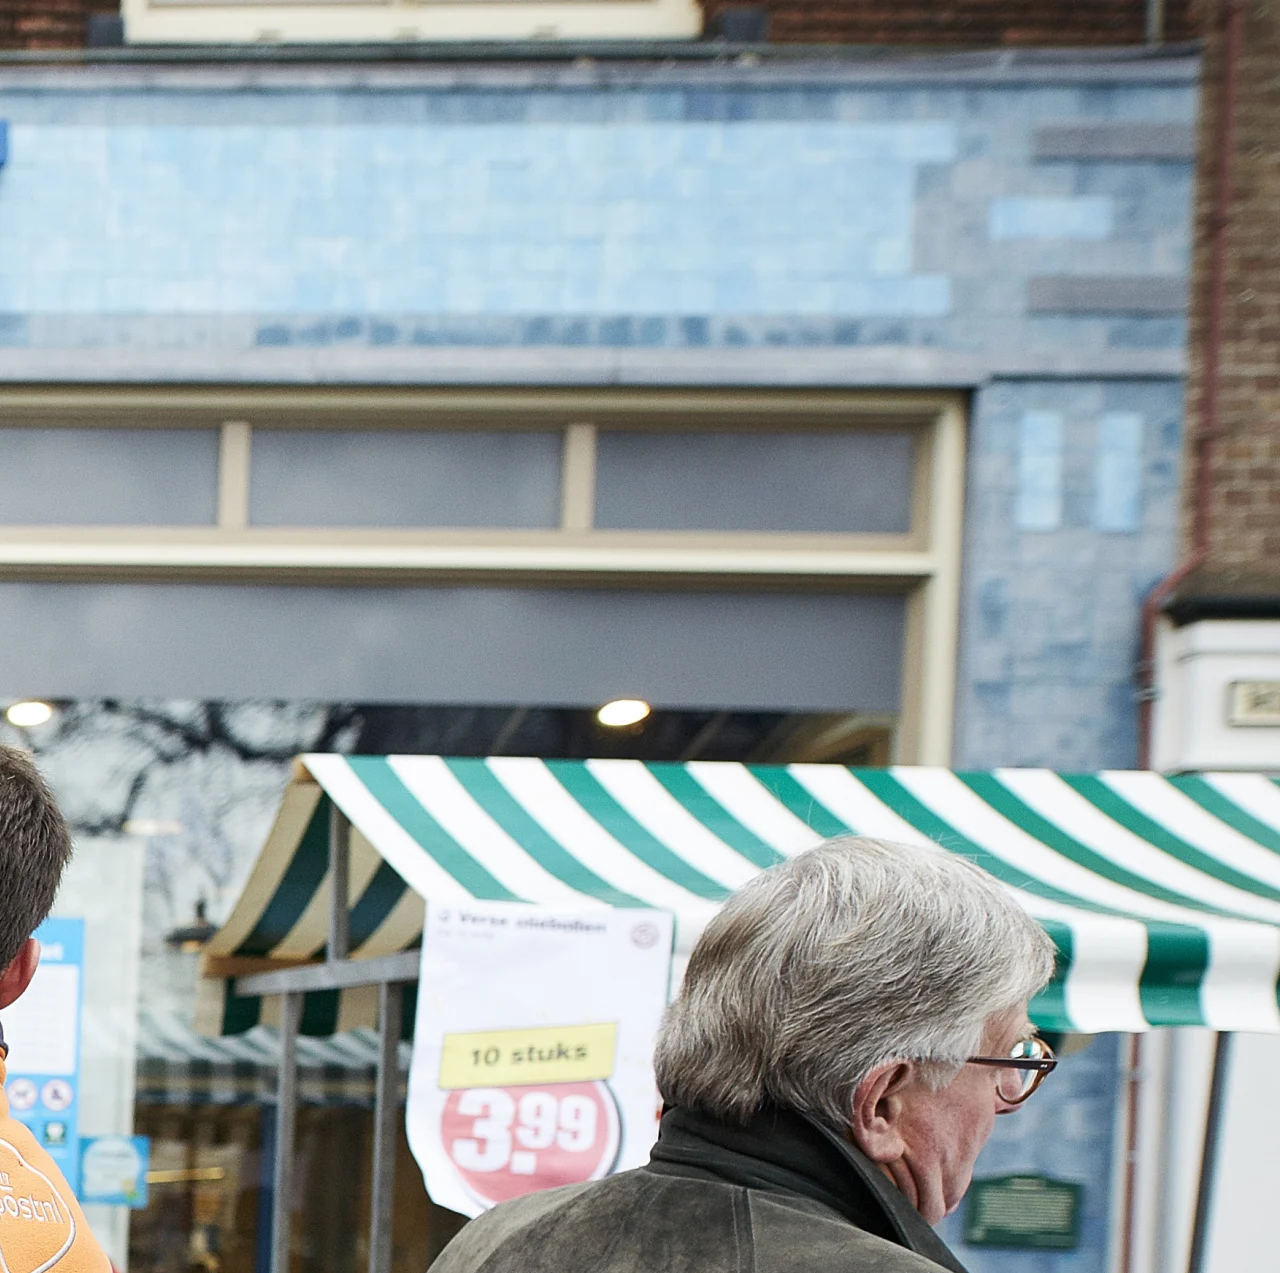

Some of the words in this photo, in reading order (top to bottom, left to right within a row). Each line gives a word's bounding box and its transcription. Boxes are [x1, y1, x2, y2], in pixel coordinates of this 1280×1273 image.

[472, 1045, 501, 1067] 10
[511, 1041, 588, 1065] stuks
[452, 1089, 598, 1174] 3.99
